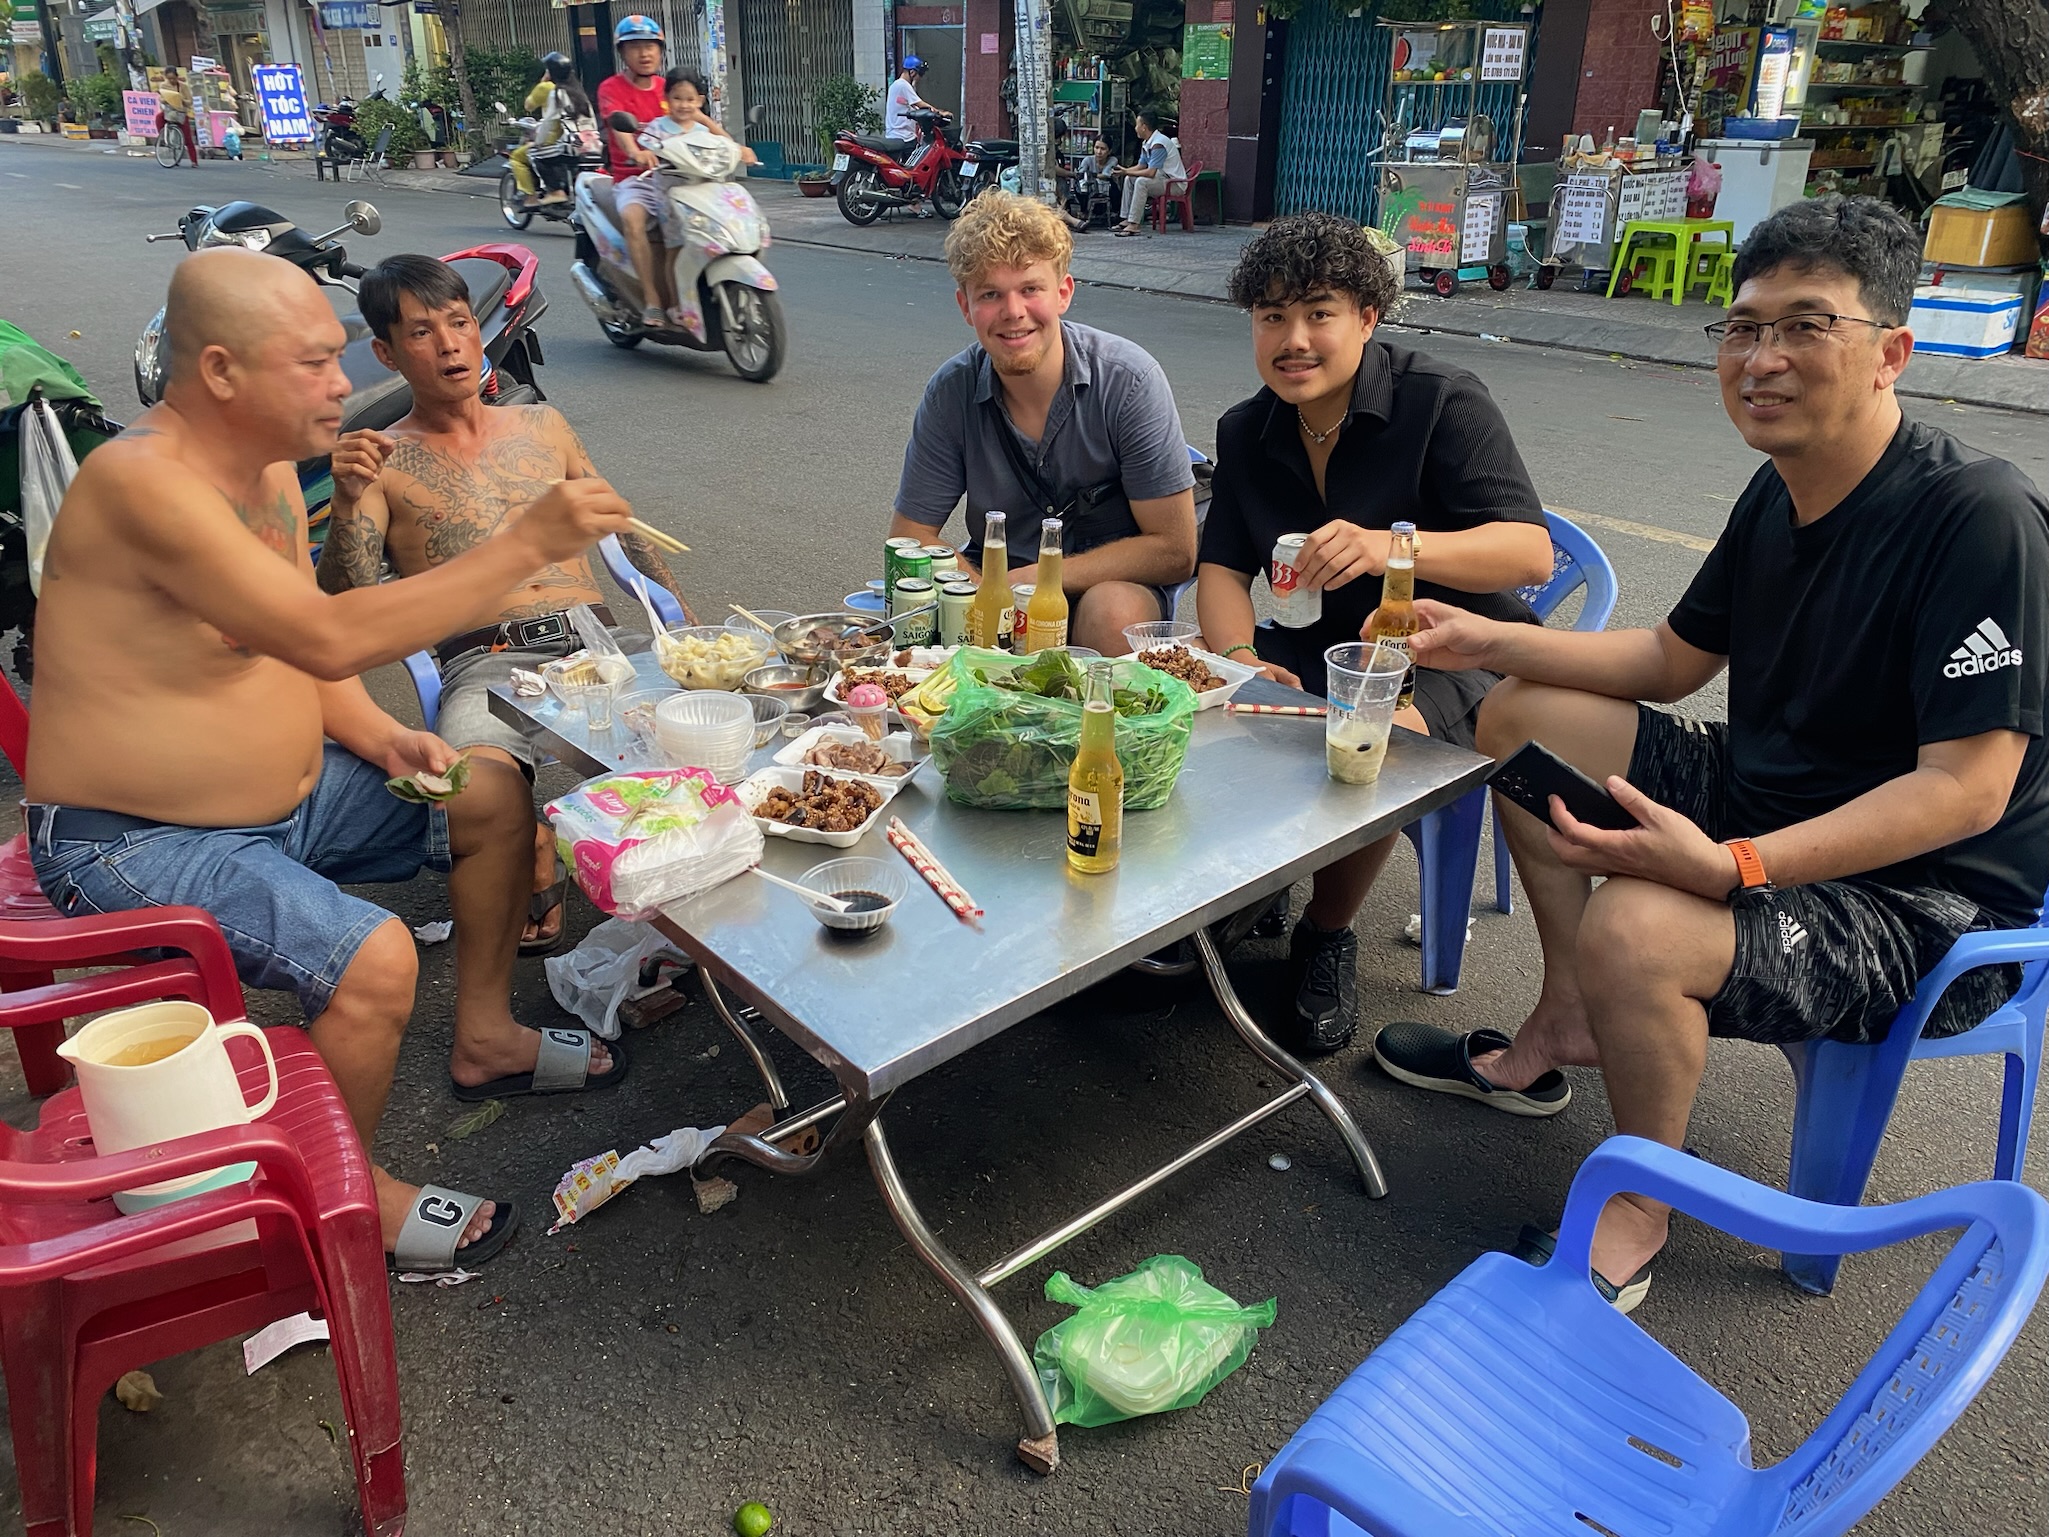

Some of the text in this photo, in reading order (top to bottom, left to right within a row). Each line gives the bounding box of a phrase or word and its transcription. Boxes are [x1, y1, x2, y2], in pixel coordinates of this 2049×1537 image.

[267, 94, 301, 115] TÓC
[269, 118, 309, 136] NAM
[1943, 649, 2023, 678] adidas
[1778, 910, 1792, 954] adidas
[416, 1194, 465, 1228] G
